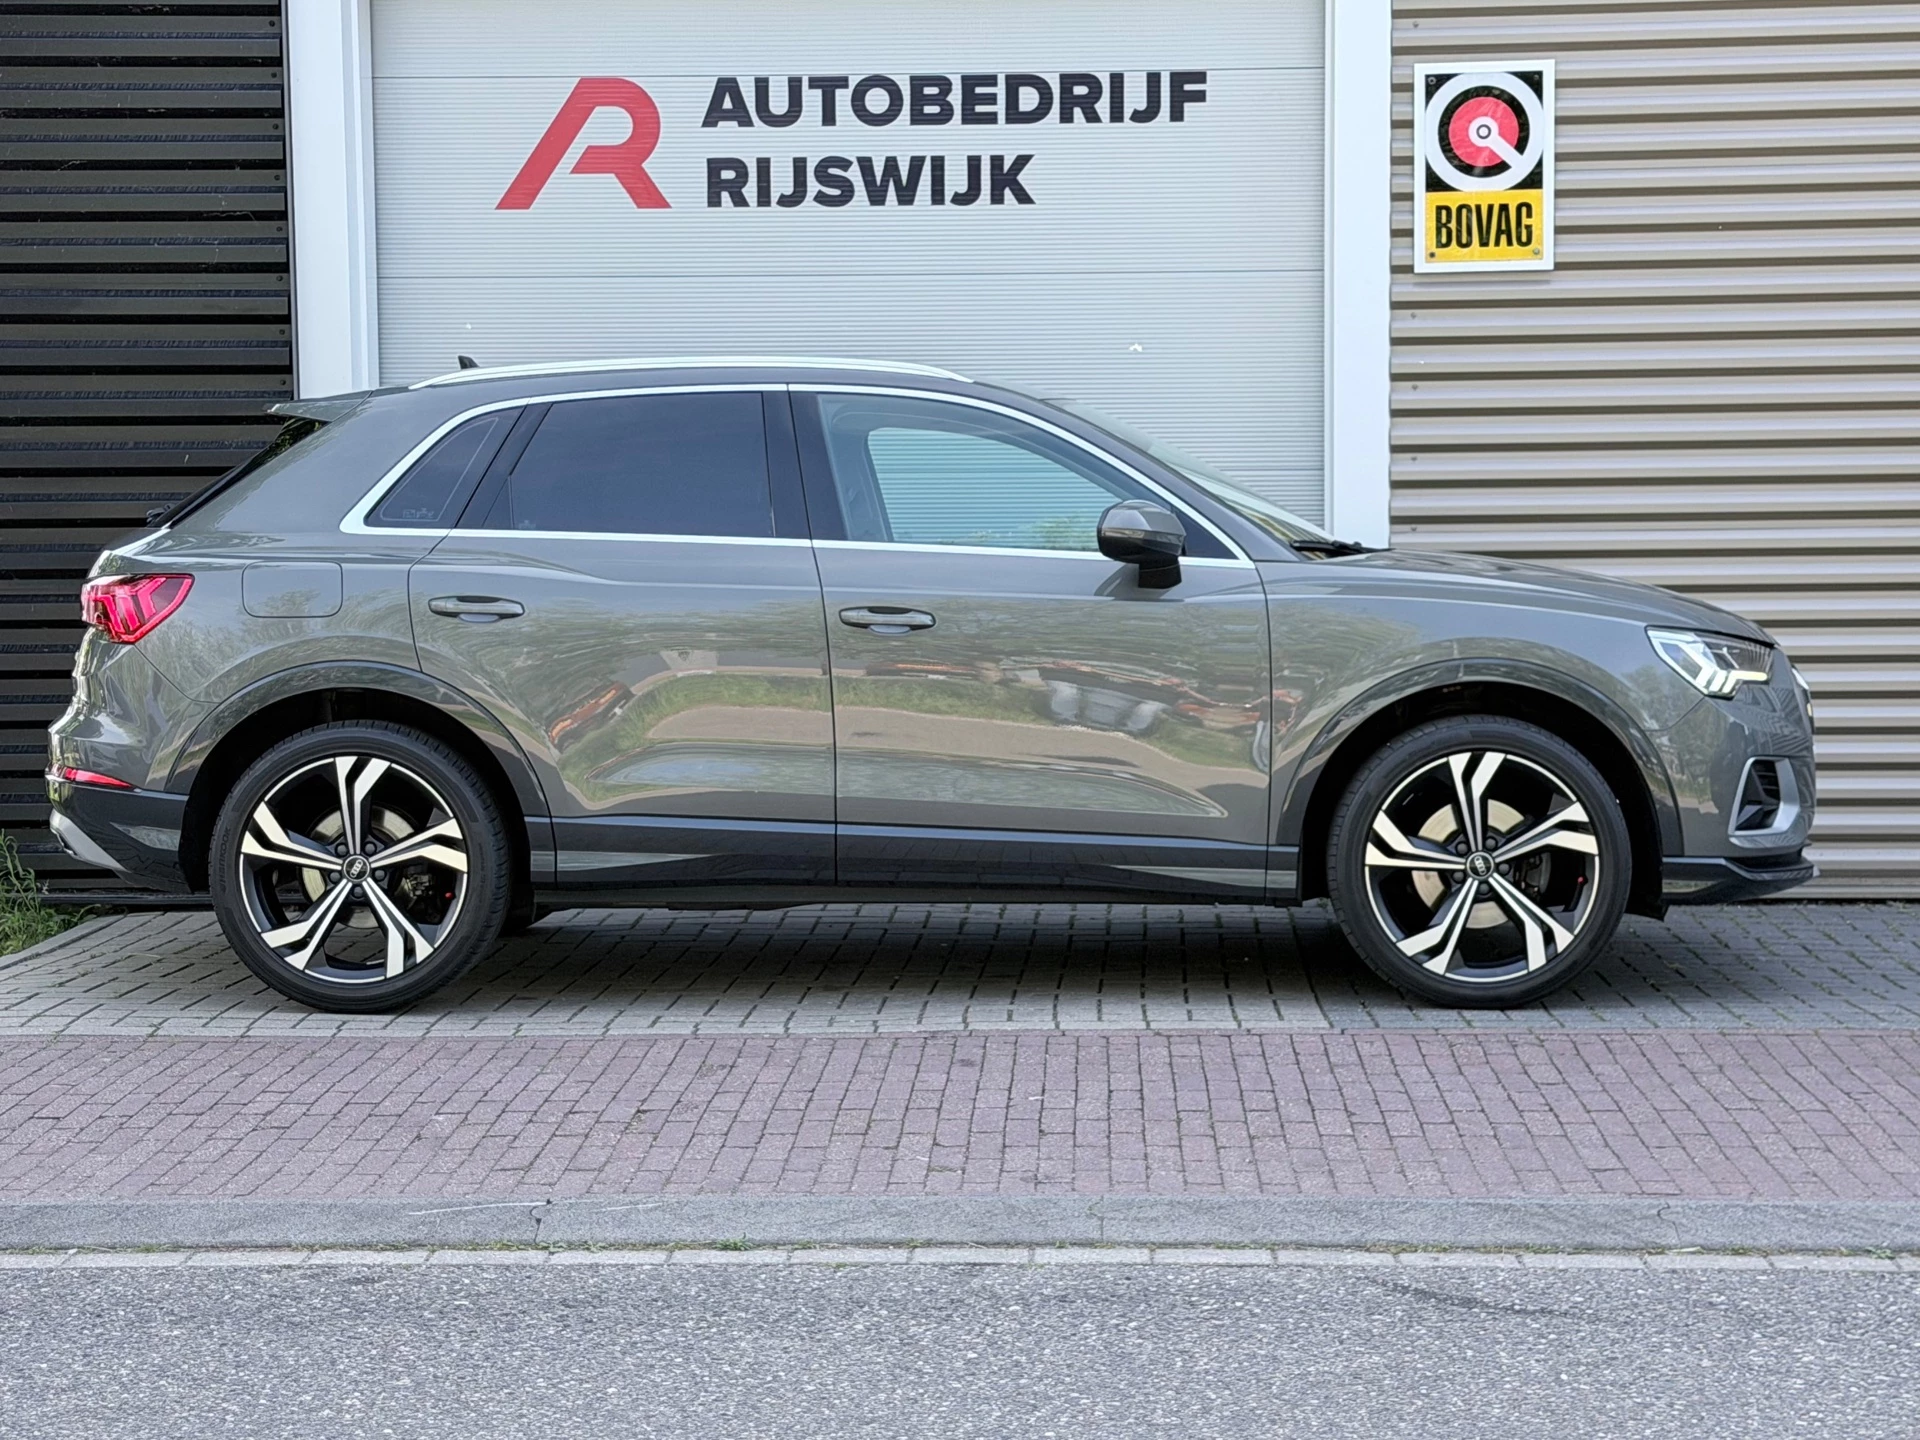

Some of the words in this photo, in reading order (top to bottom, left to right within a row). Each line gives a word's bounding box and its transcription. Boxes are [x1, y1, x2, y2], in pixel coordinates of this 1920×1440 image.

[702, 71, 1208, 128] AUTOBEDRIJF
[706, 154, 1037, 208] RIJSWIJK
[1435, 201, 1533, 249] BOVAG
